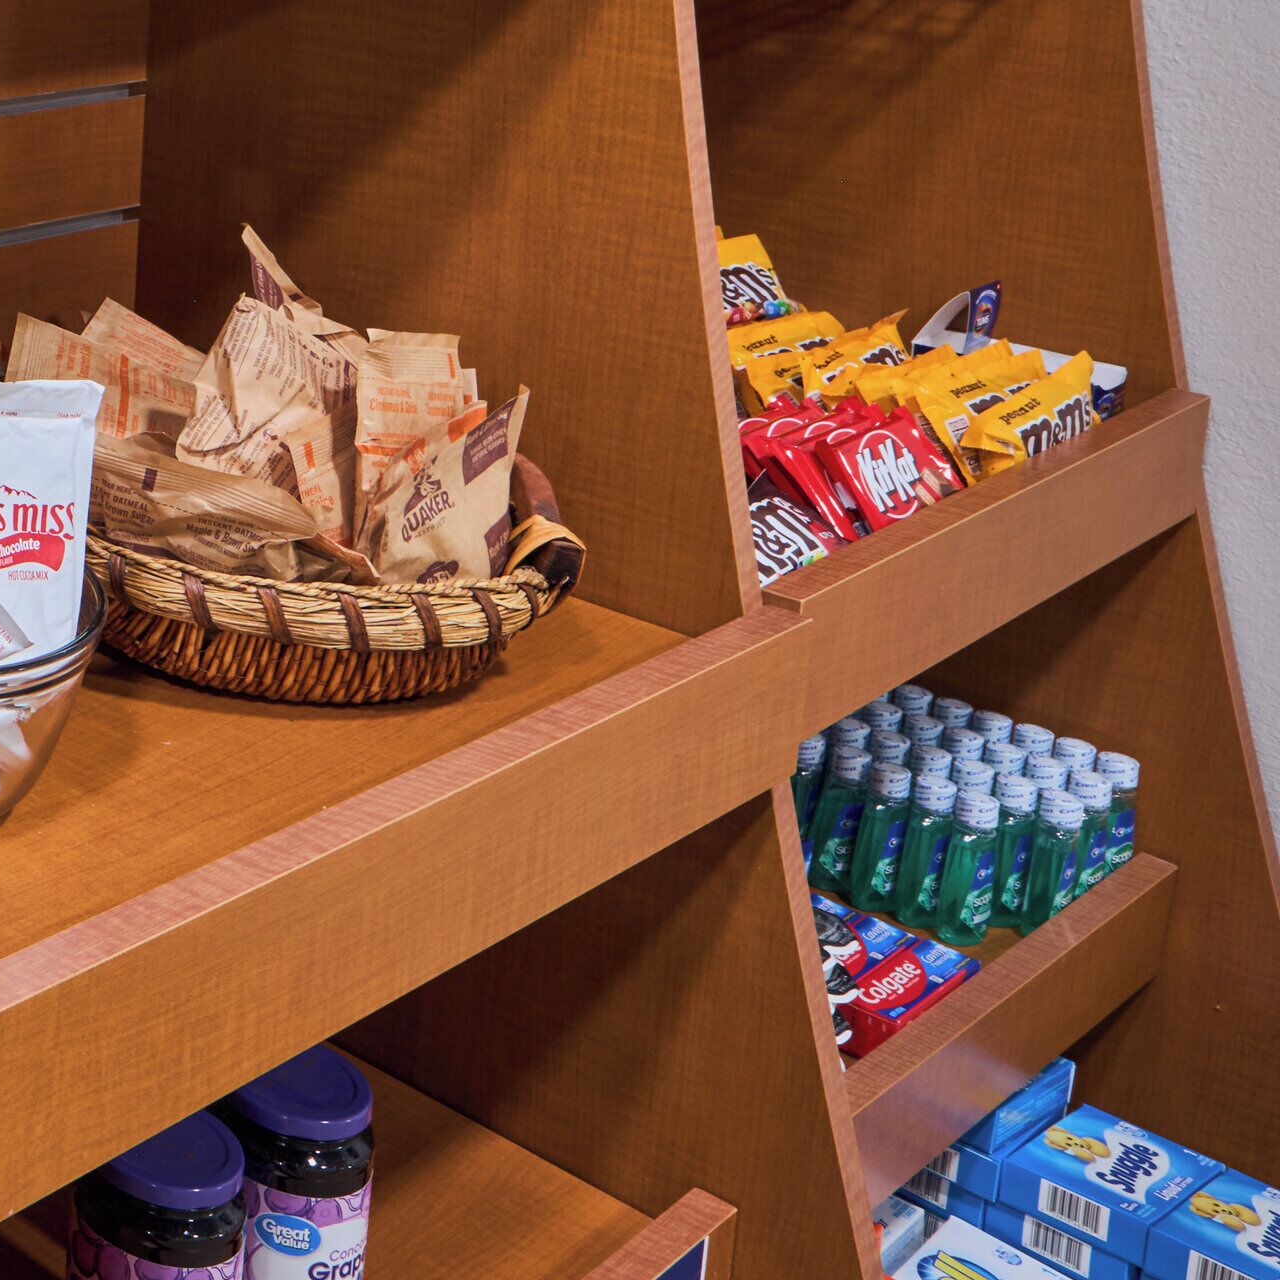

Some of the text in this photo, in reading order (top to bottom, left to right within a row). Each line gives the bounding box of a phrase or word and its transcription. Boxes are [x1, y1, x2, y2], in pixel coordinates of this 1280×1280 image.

[999, 398, 1042, 425] peanut
[115, 483, 133, 495] HERE
[113, 495, 149, 513] OATMEAL
[130, 510, 156, 527] Sugar
[198, 517, 233, 533] INSTANT
[401, 490, 451, 544] QUAKER
[186, 523, 243, 550] Maple & Brown
[8, 571, 49, 580] HOT COCOA MIX
[921, 947, 948, 965] Cavity
[856, 961, 921, 1005] Colgate
[1096, 1142, 1159, 1194] Snuggle
[1154, 1179, 1183, 1201] Liquid
[262, 1218, 311, 1242] Great
[272, 1234, 310, 1251] Value
